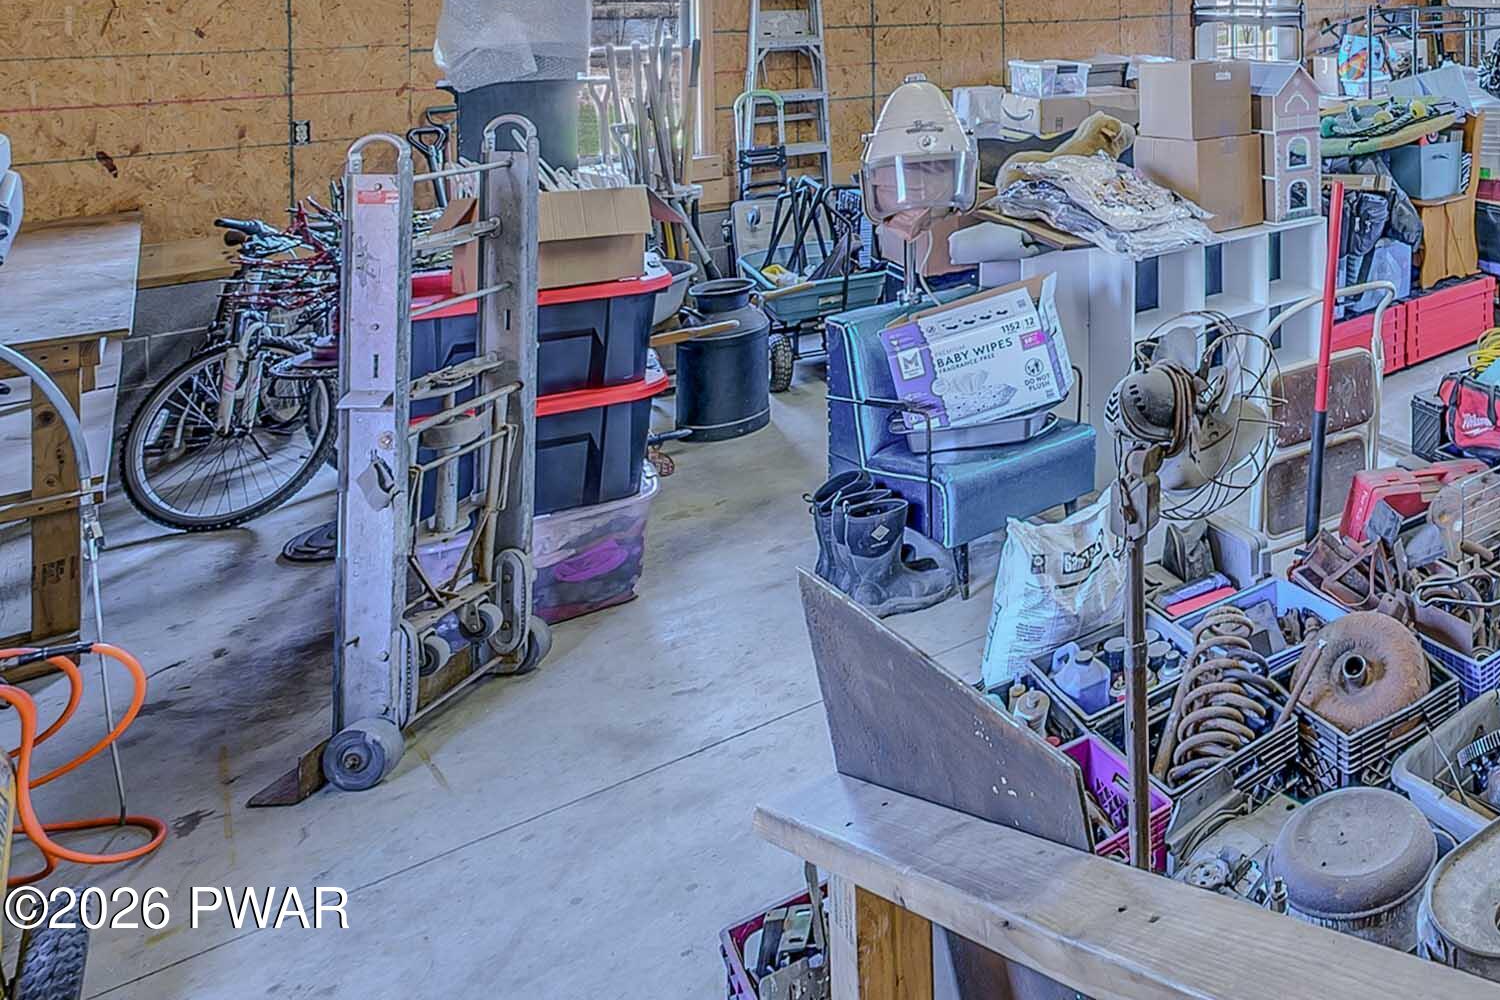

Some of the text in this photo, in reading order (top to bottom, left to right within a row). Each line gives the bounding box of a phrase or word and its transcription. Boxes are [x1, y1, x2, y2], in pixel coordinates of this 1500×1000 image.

[1001, 321, 1021, 334] 1152
[937, 349, 969, 369] BABY
[973, 336, 1013, 357] WIPES
[938, 353, 996, 375] FRAGRANCE FREE
[1024, 372, 1050, 386] DO NOT
